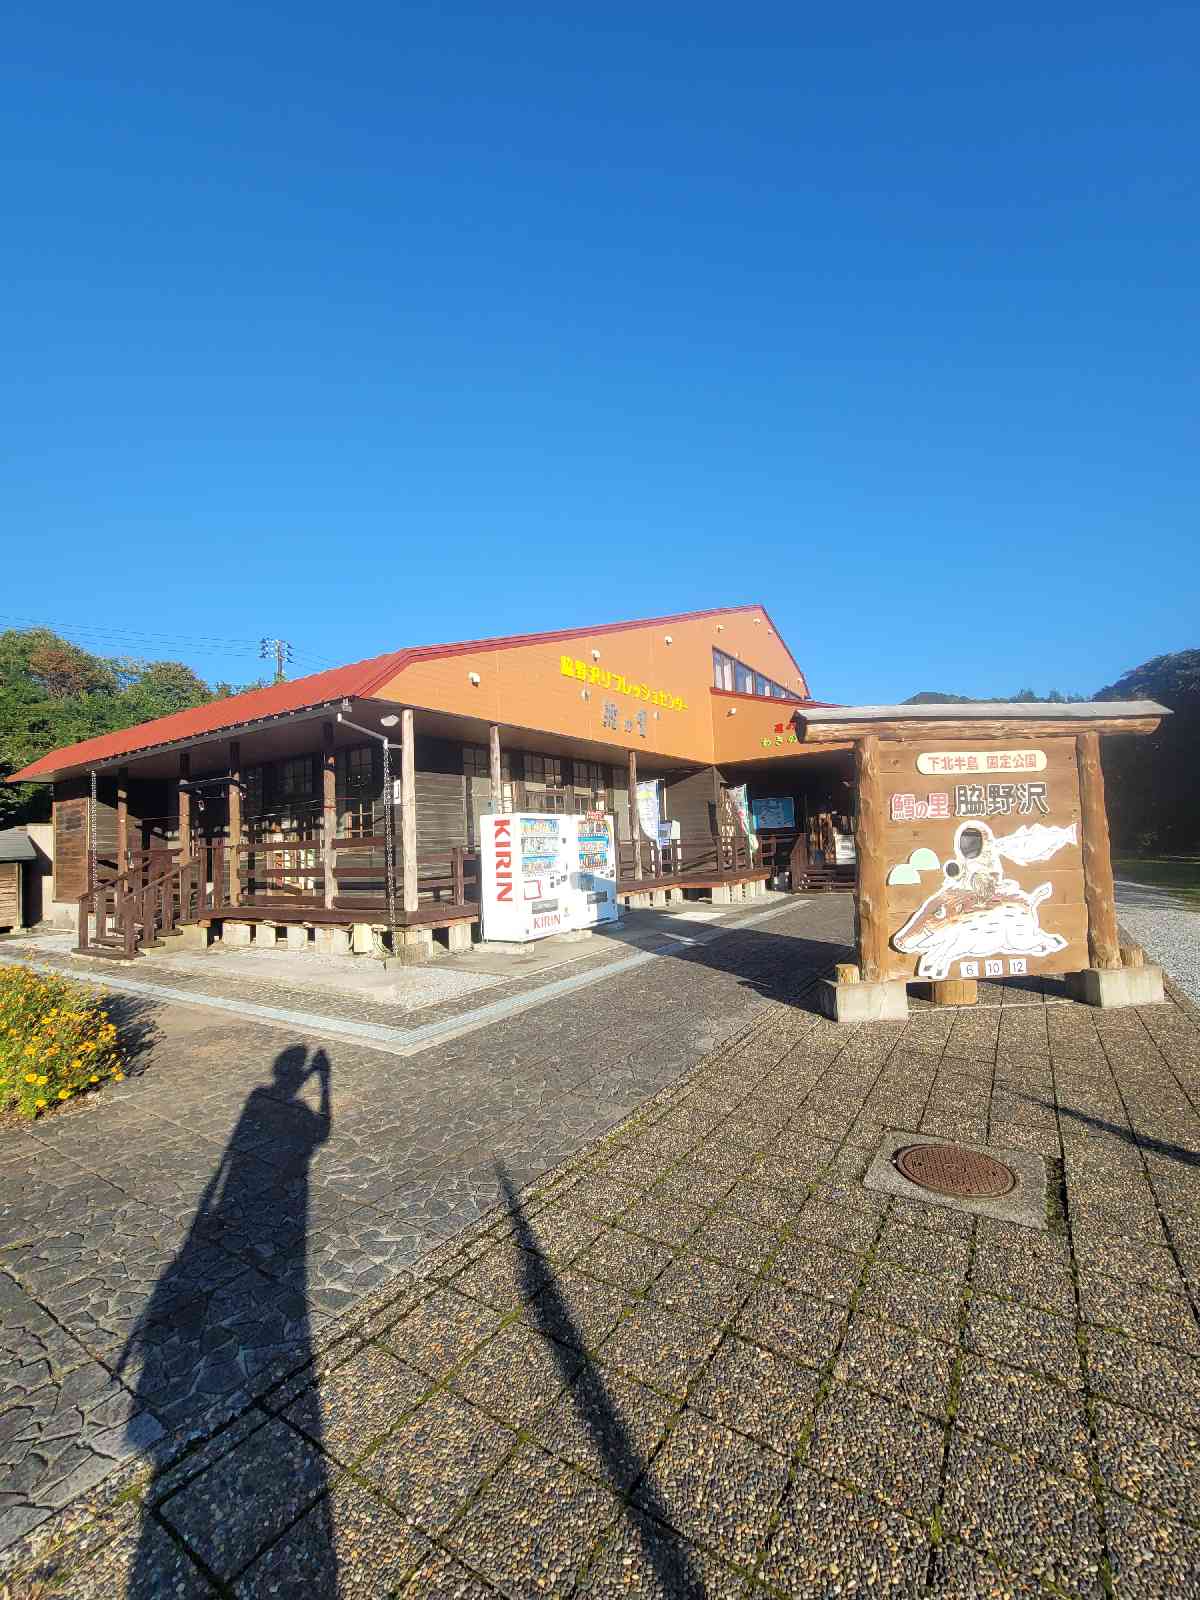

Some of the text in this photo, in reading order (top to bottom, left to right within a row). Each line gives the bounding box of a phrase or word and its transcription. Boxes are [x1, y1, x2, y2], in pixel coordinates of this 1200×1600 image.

[928, 753, 1037, 771] 下北半島 国定公園
[891, 783, 1049, 820] 鱈の里 脇野沢
[494, 819, 513, 901] KIRIN
[533, 913, 560, 930] KIRIN
[987, 962, 1000, 974] 10
[1013, 961, 1024, 973] 12
